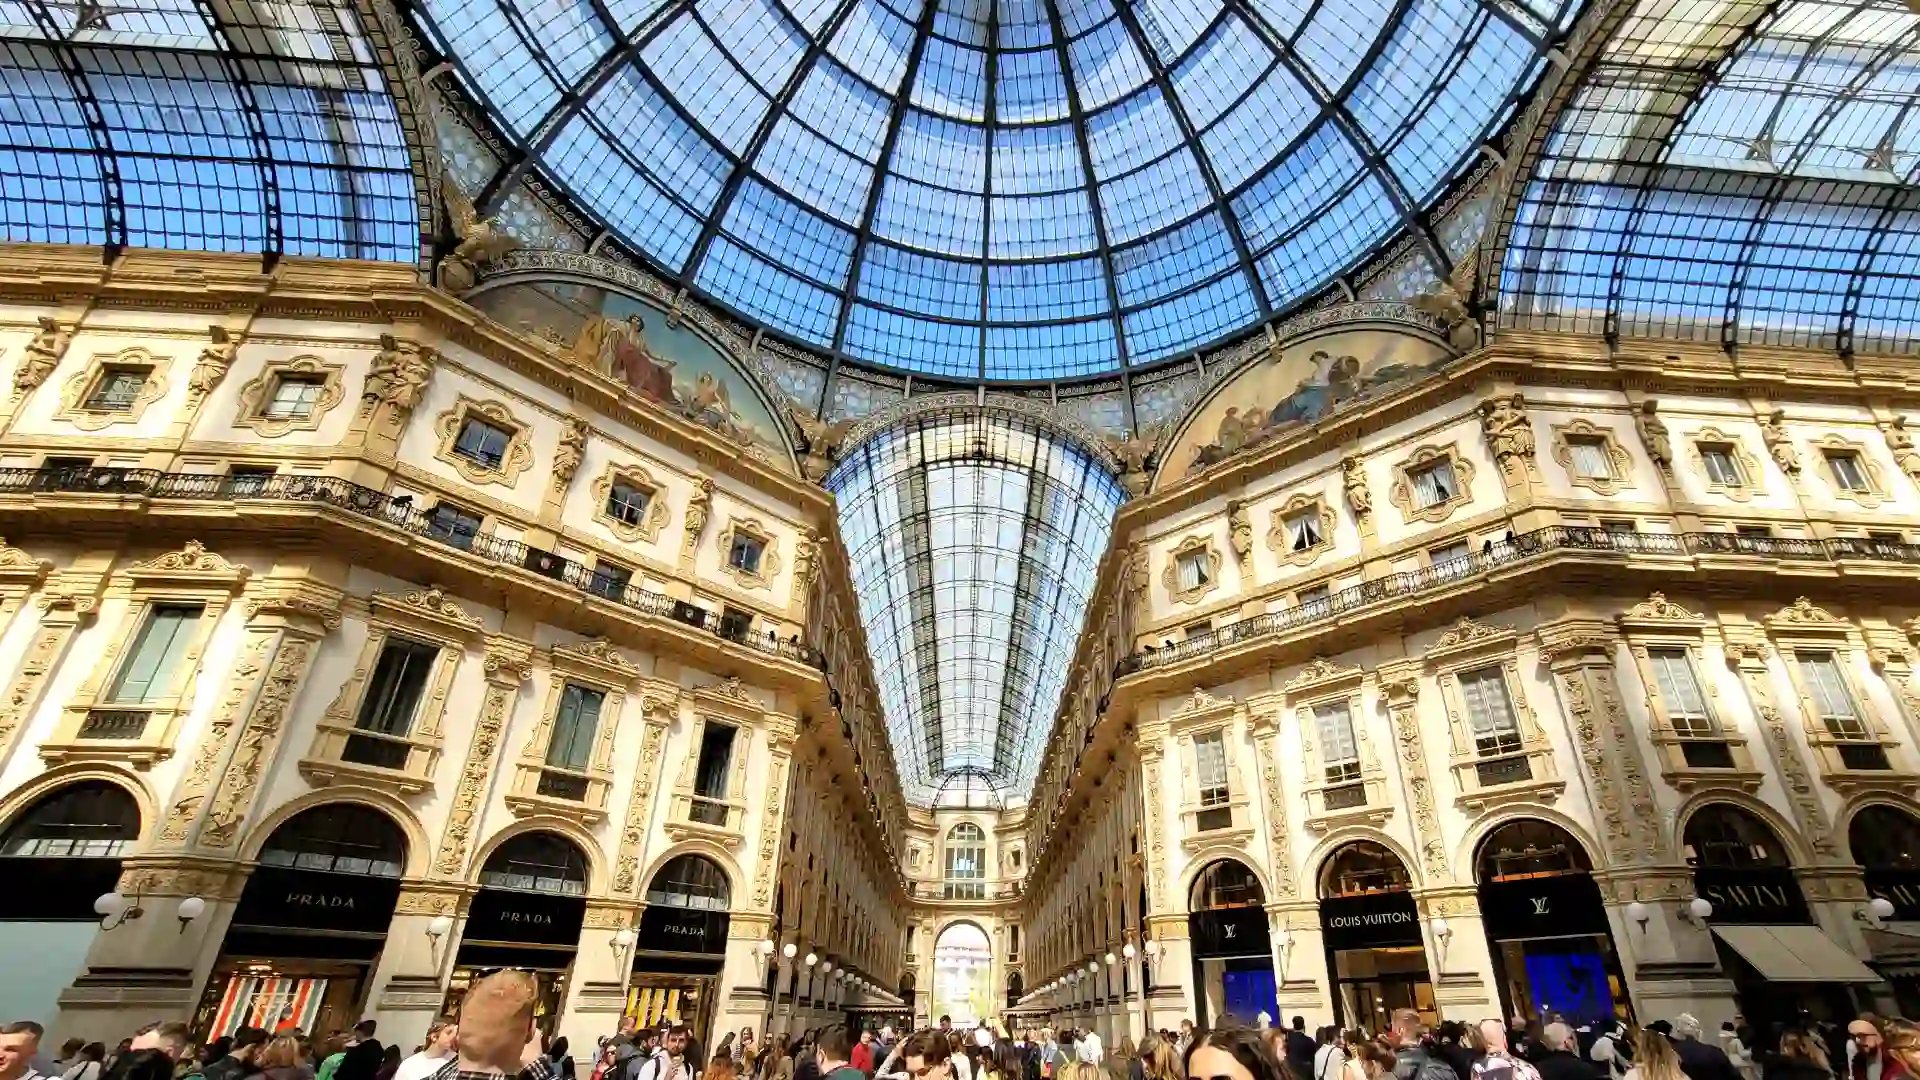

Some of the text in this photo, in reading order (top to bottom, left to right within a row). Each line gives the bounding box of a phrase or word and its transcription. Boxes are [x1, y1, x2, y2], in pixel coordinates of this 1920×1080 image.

[285, 893, 355, 908] PRADA
[500, 911, 551, 924] PRADA
[1330, 911, 1411, 928] LOUIS VUITTON
[664, 924, 705, 936] PRADA
